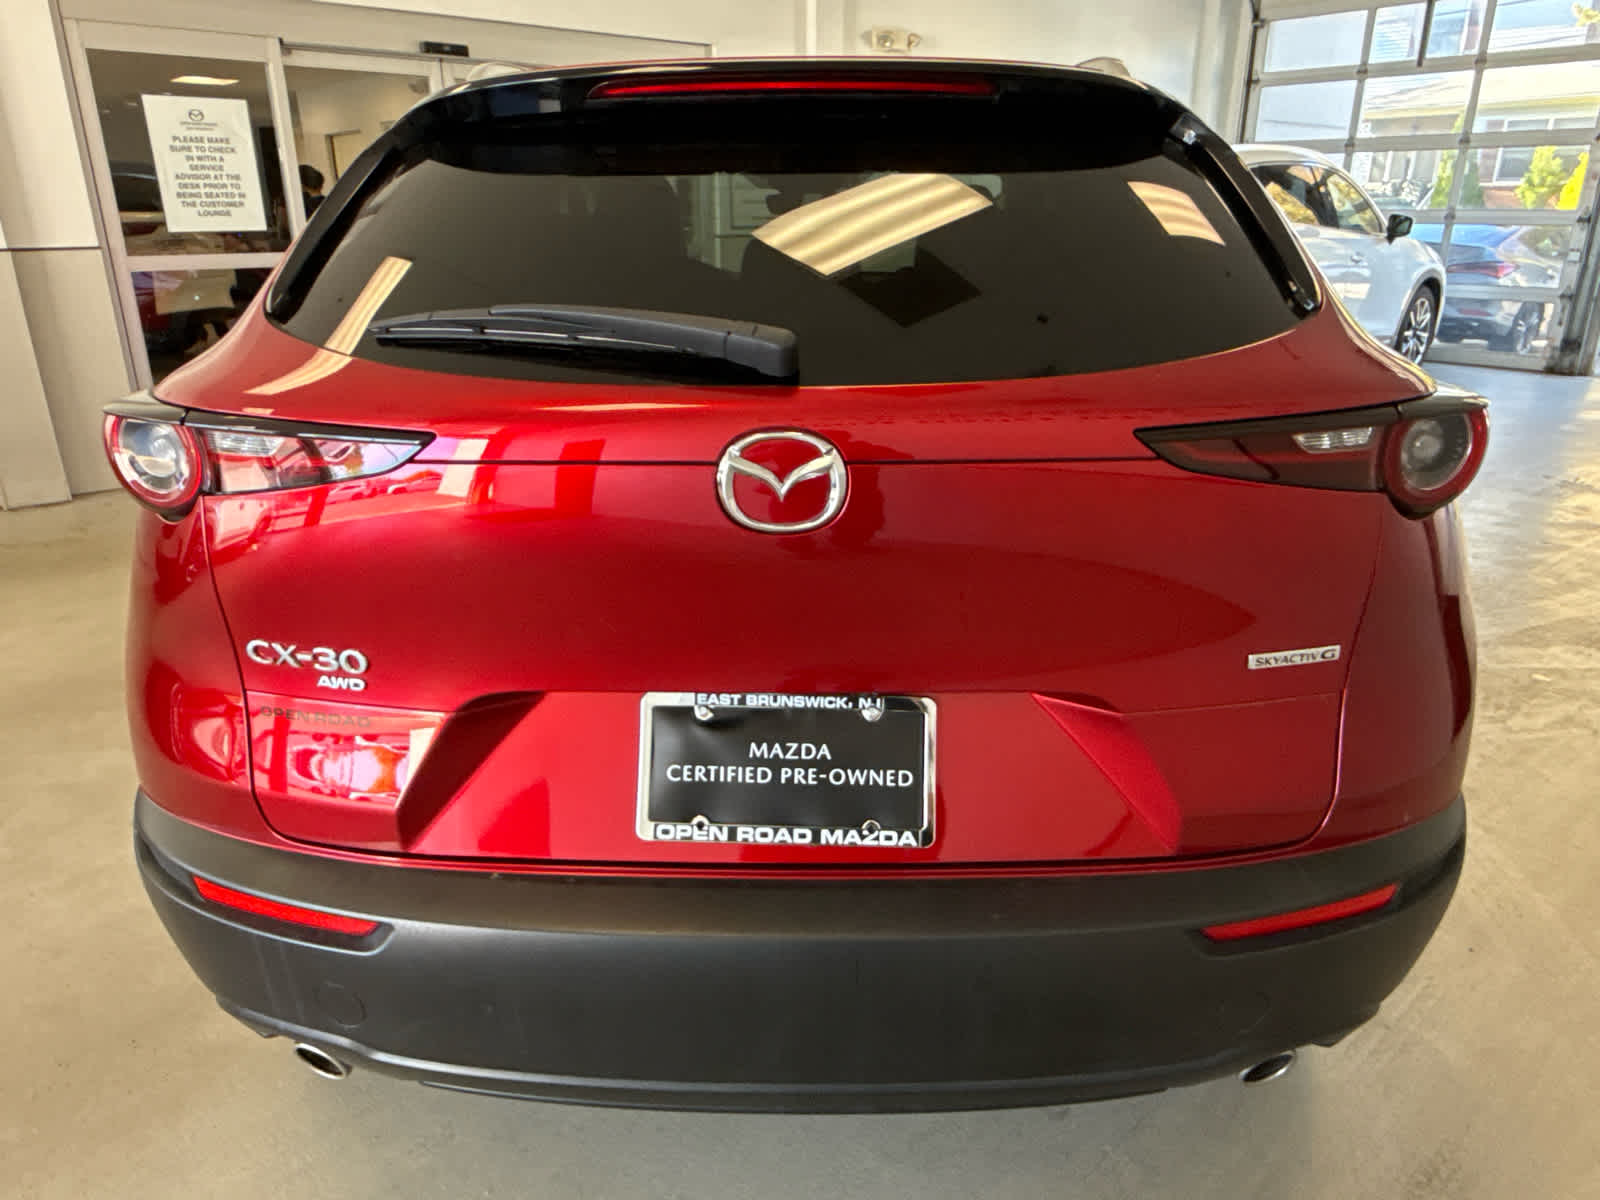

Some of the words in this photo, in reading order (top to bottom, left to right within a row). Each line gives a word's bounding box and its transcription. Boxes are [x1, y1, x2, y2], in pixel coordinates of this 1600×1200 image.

[172, 135, 205, 143] PLEASE
[207, 136, 231, 144] MAKE
[199, 200, 245, 208] CUSTOMER
[245, 639, 369, 675] CX-30
[316, 674, 367, 692] AWD
[696, 693, 741, 706] EAST
[260, 705, 310, 721] OPEN
[313, 711, 371, 728] ROAD
[748, 742, 832, 761] MAZDA
[665, 764, 773, 784] CERTIFIED
[780, 768, 914, 787] PRE-OWNED
[655, 824, 729, 842] OPEN
[736, 826, 812, 845] ROAD
[820, 828, 917, 848] MAZDA
